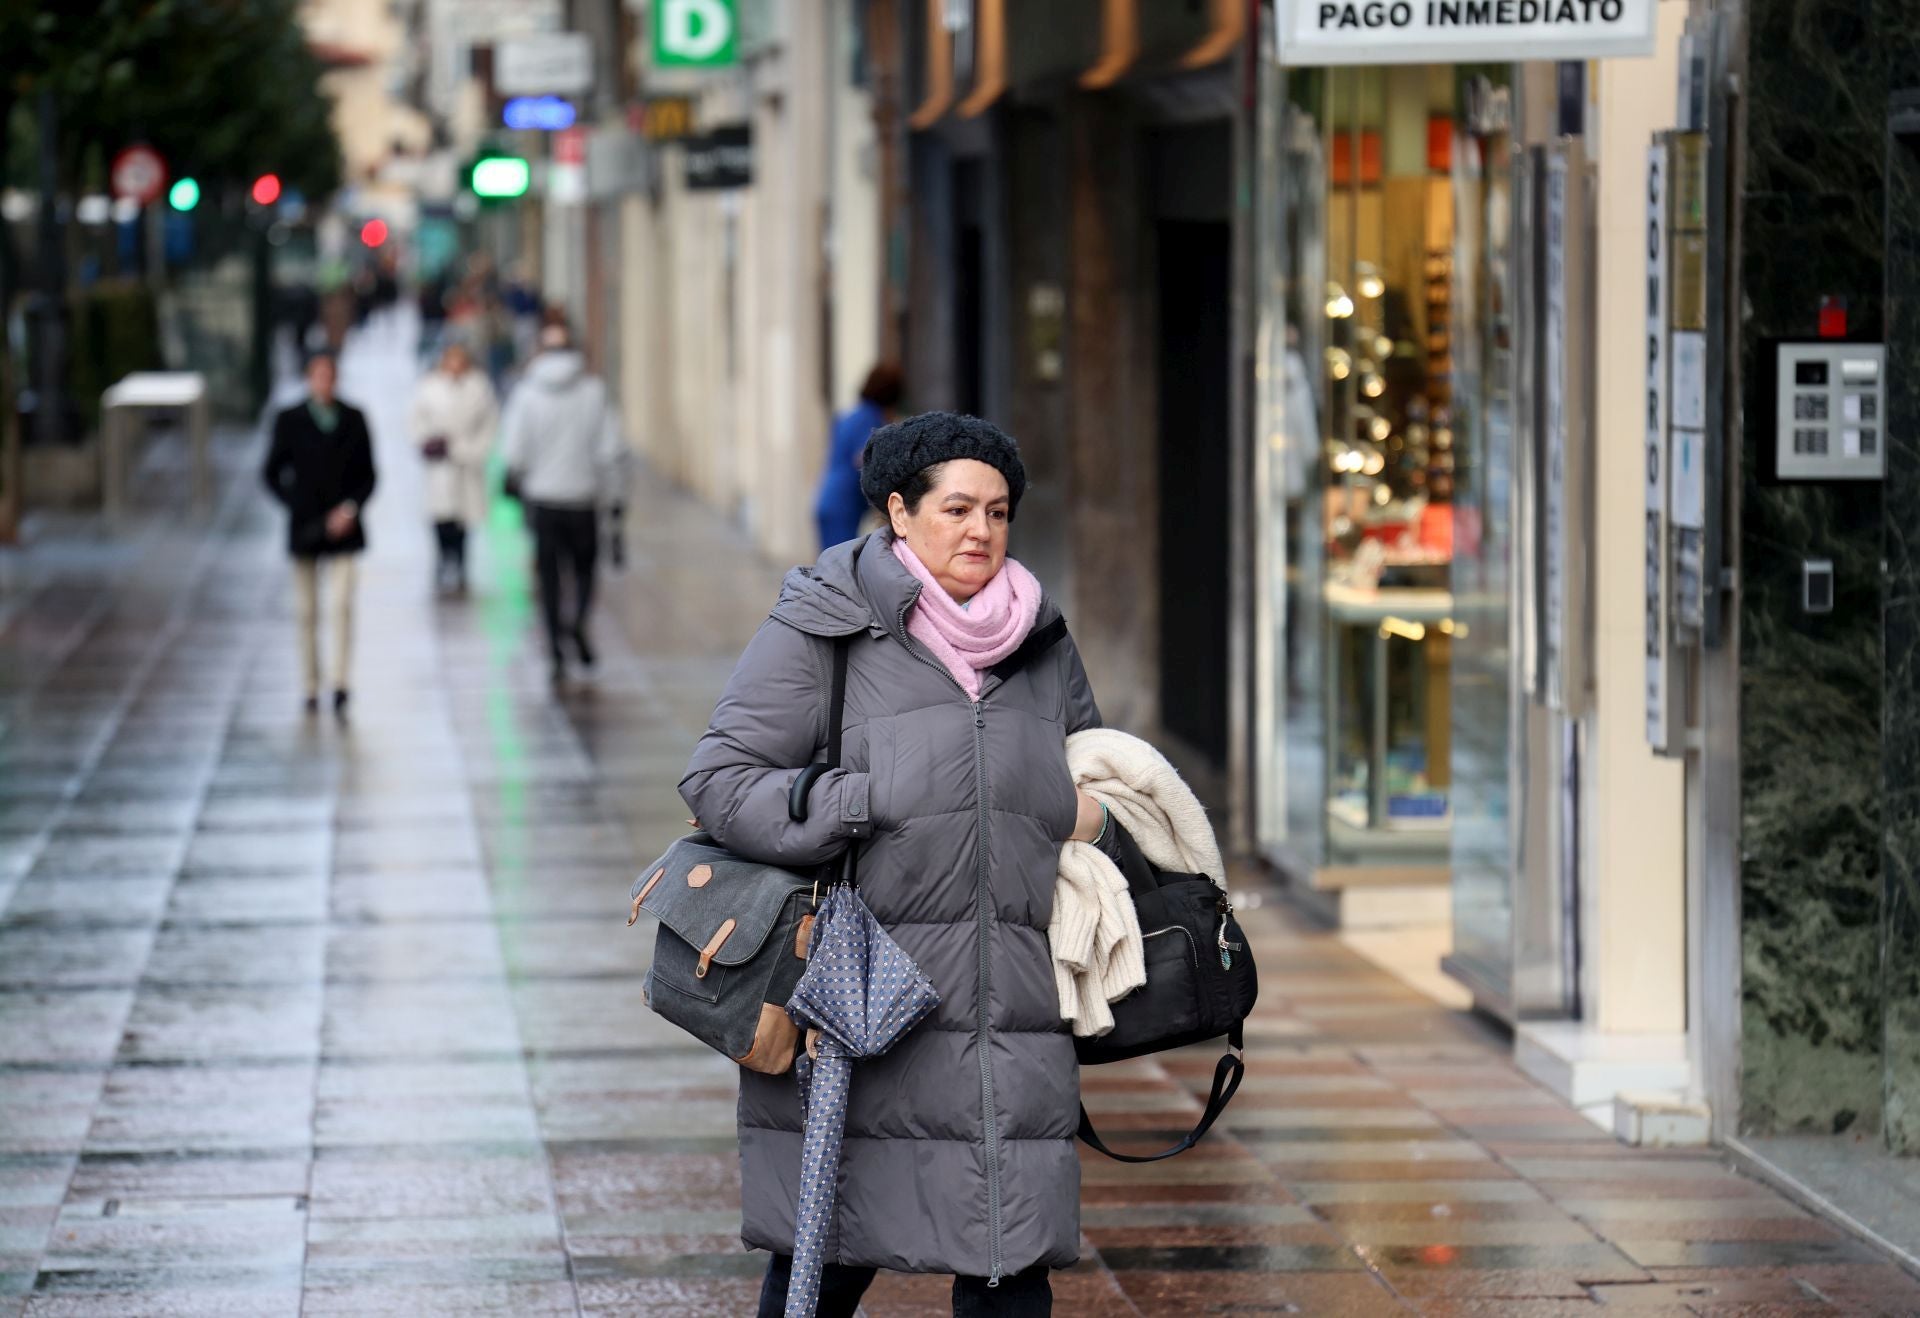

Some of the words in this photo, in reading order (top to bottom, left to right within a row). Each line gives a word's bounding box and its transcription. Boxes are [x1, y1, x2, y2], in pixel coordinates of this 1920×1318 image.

[661, 0, 729, 58] D
[1318, 2, 1412, 29] PAGO
[1426, 0, 1624, 27] INMEDIATO
